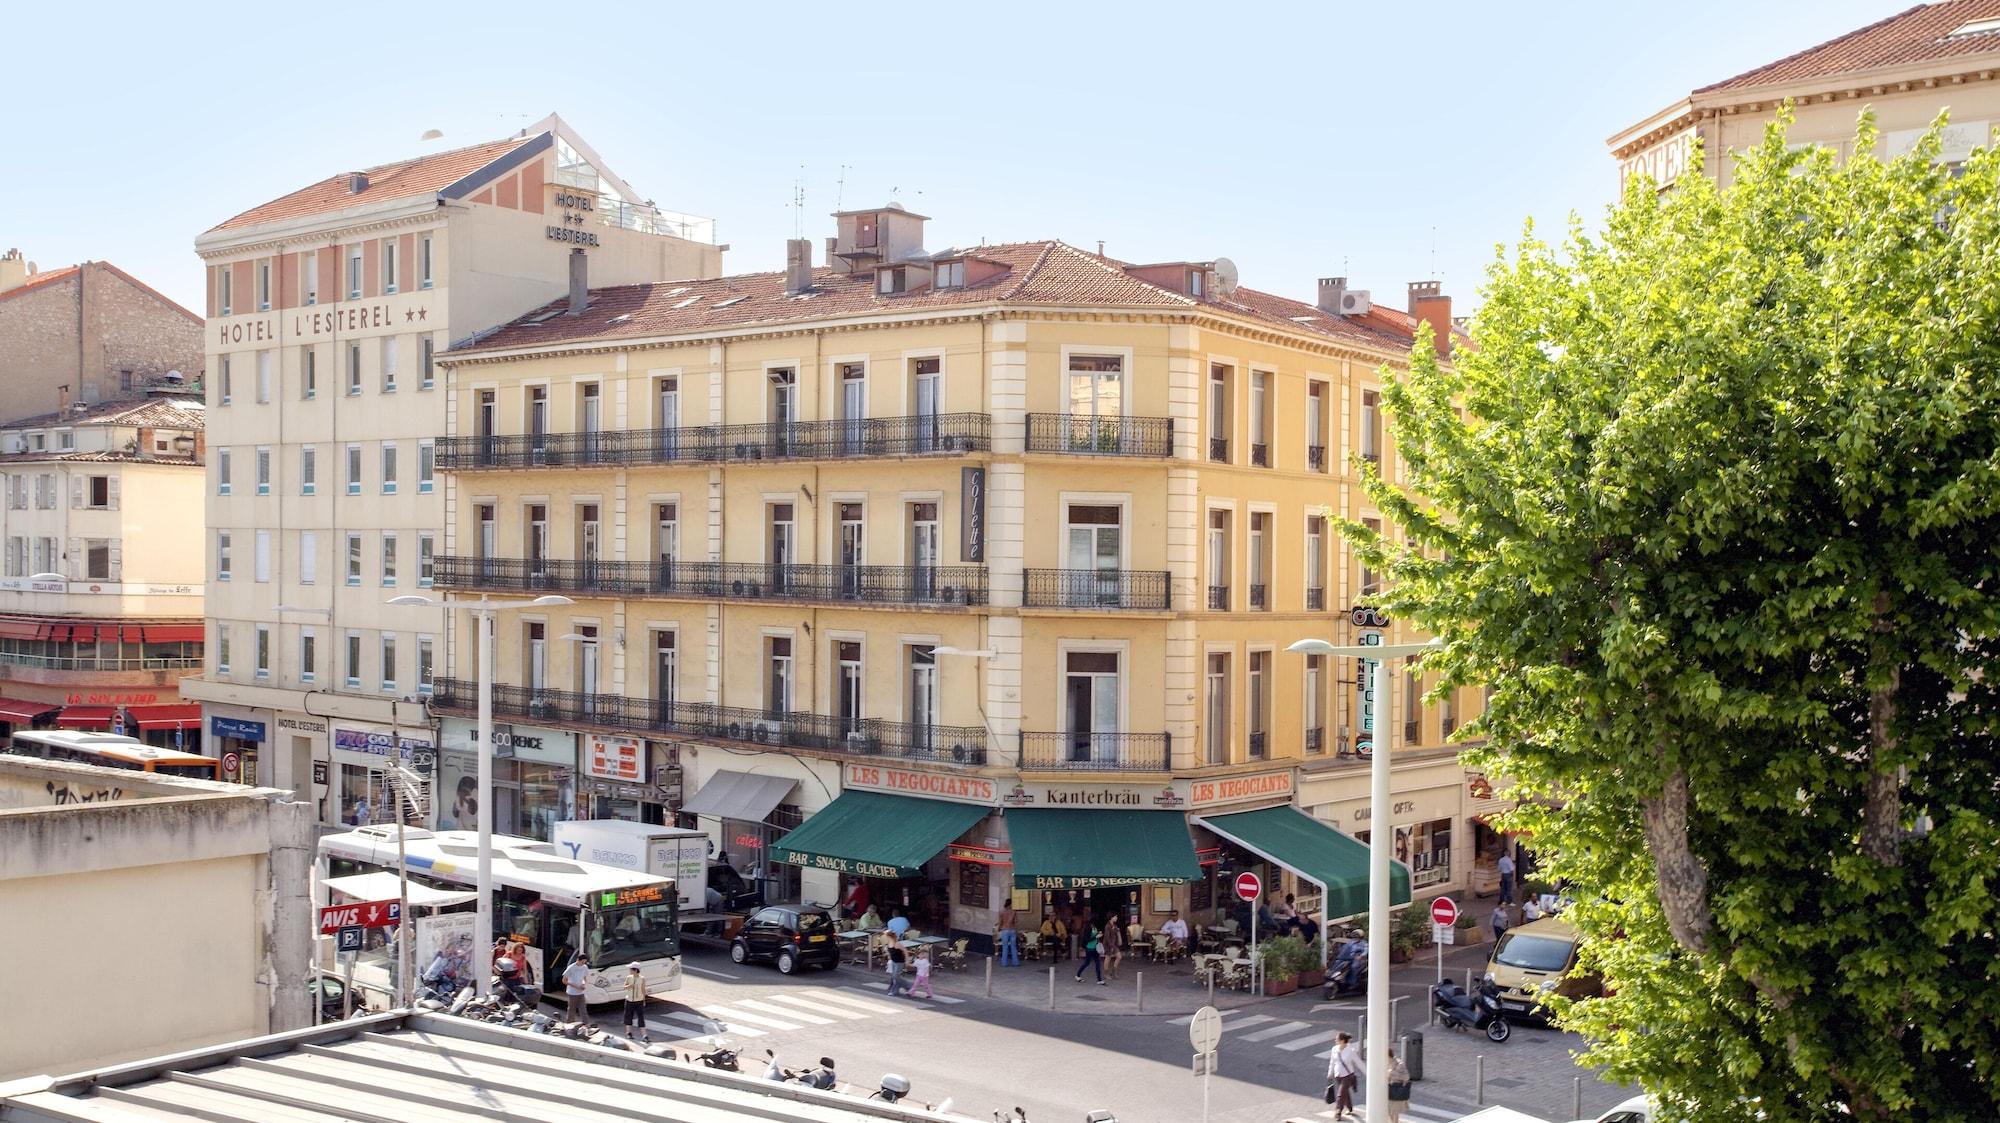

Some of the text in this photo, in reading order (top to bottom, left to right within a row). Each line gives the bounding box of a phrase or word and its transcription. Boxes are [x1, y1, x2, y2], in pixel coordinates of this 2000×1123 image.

[555, 192, 594, 212] HOTEL
[546, 225, 600, 247] L'ESTEREL
[220, 305, 392, 344] HOTEL L'ESTEREL
[1364, 634, 1379, 730] OTIQUE
[278, 718, 297, 729] HOTEL
[851, 767, 992, 799] LES NEGOCIANTS
[1192, 774, 1289, 802] LES NEGOCIANTS
[1047, 789, 1141, 805] Kanterbräu
[788, 851, 808, 866] BAR
[815, 855, 847, 871] SNACK
[856, 862, 899, 878] GLACIER
[1036, 876, 1064, 889] BAR
[1072, 877, 1097, 888] DES
[322, 904, 399, 928] AVIS P
[345, 932, 353, 946] P
